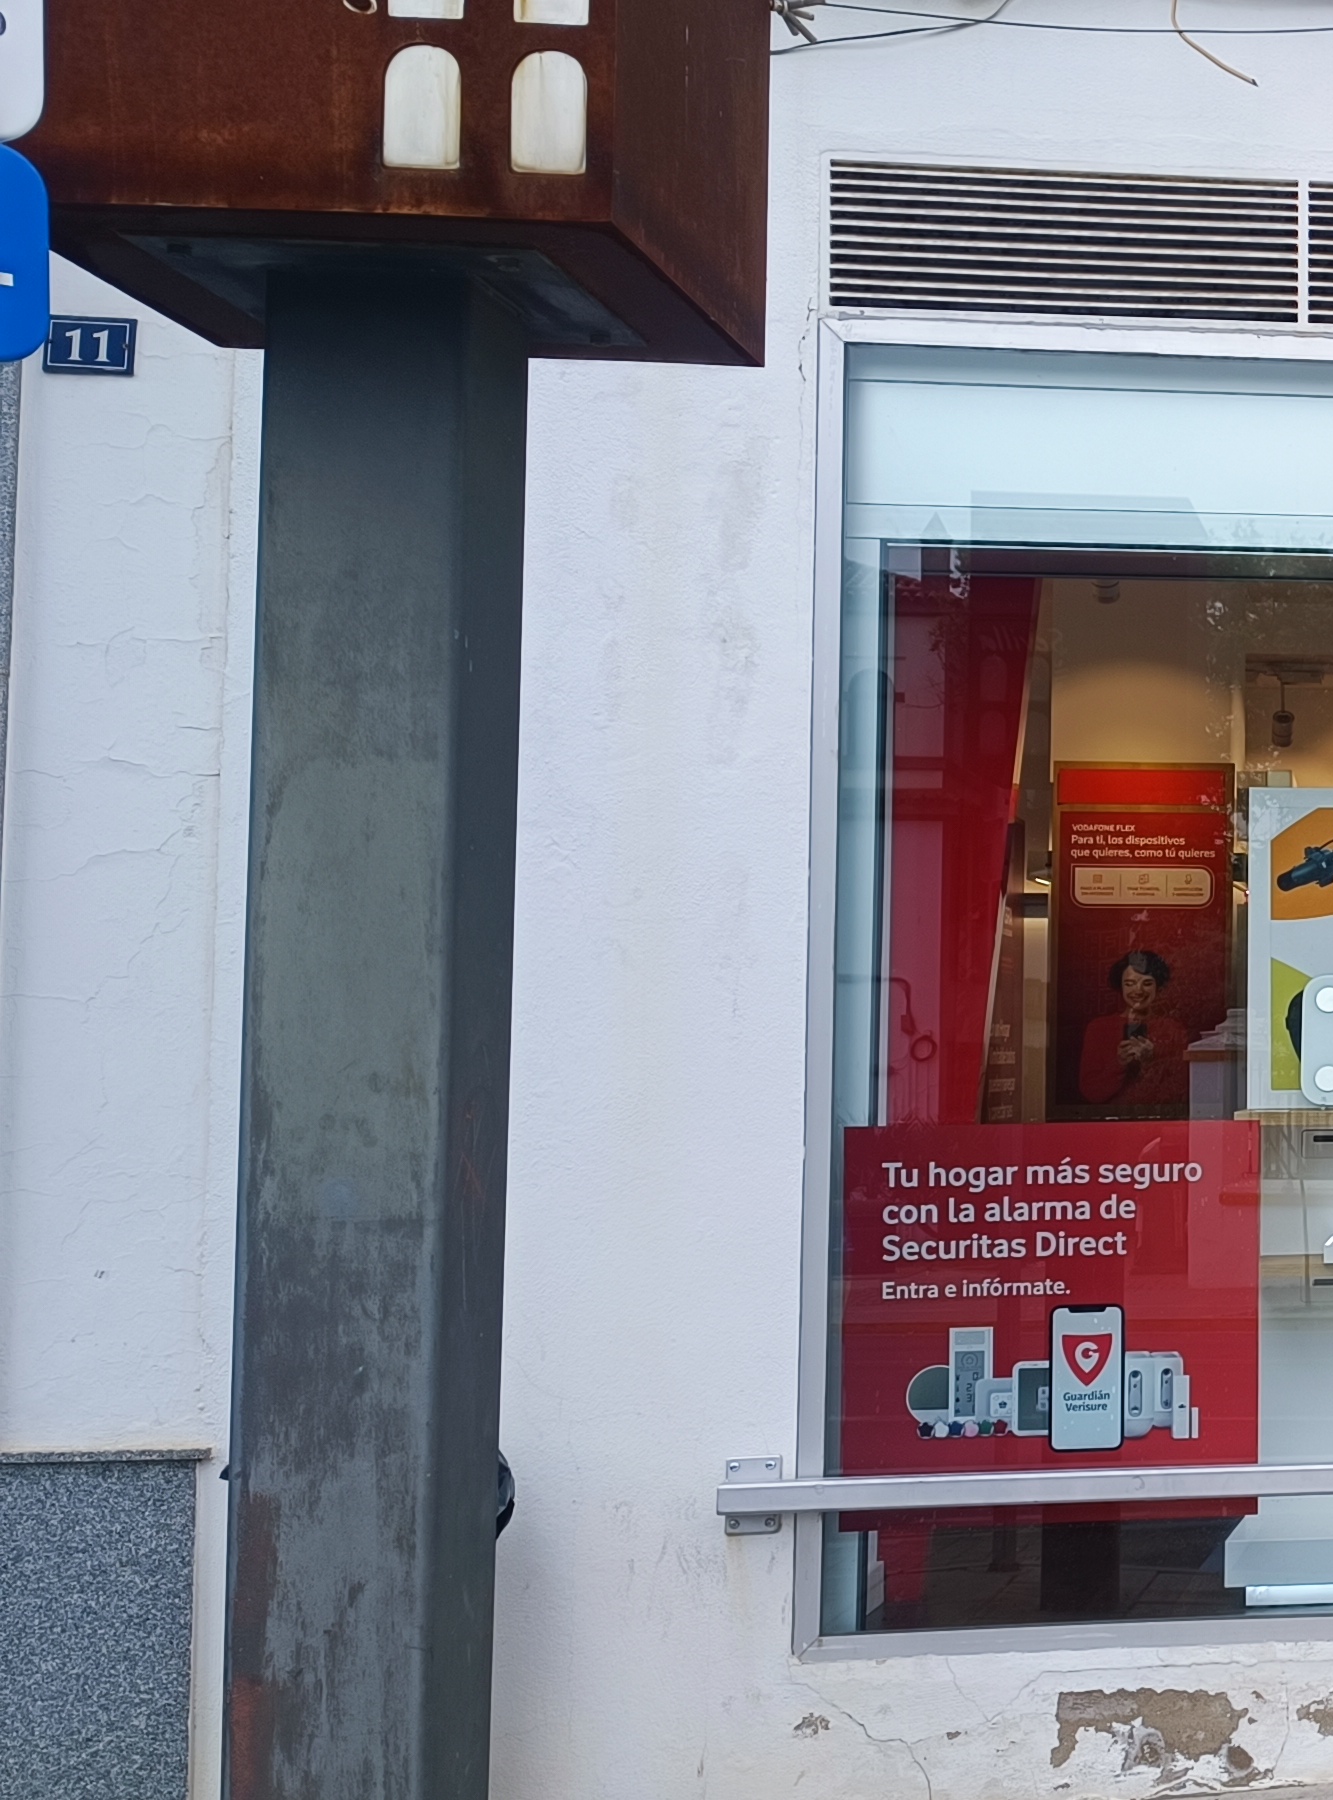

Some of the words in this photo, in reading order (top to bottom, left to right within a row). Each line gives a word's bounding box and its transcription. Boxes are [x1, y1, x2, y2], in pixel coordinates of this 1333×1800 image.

[65, 328, 110, 362] 11
[1071, 835, 1093, 844] Para
[1108, 835, 1123, 845] los
[1125, 835, 1186, 847] dispositivos
[1070, 849, 1090, 858] que
[1134, 850, 1163, 858] como
[1165, 847, 1176, 858] tú
[1178, 849, 1216, 860] quieres
[882, 1162, 919, 1188] Tu
[929, 1161, 1018, 1193] hogar
[1026, 1157, 1090, 1185] más
[1098, 1161, 1202, 1190] seguro
[882, 1204, 938, 1225] con
[948, 1197, 976, 1223] la
[984, 1196, 1091, 1222] alarma
[1100, 1194, 1136, 1219] de
[882, 1233, 1026, 1261] Securitas
[1036, 1231, 1127, 1257] Direct
[882, 1281, 939, 1300] Entra
[944, 1284, 957, 1298] e
[962, 1278, 1071, 1298] infórmate.
[1063, 1390, 1111, 1401] Guardián
[1065, 1402, 1108, 1412] Verisure
